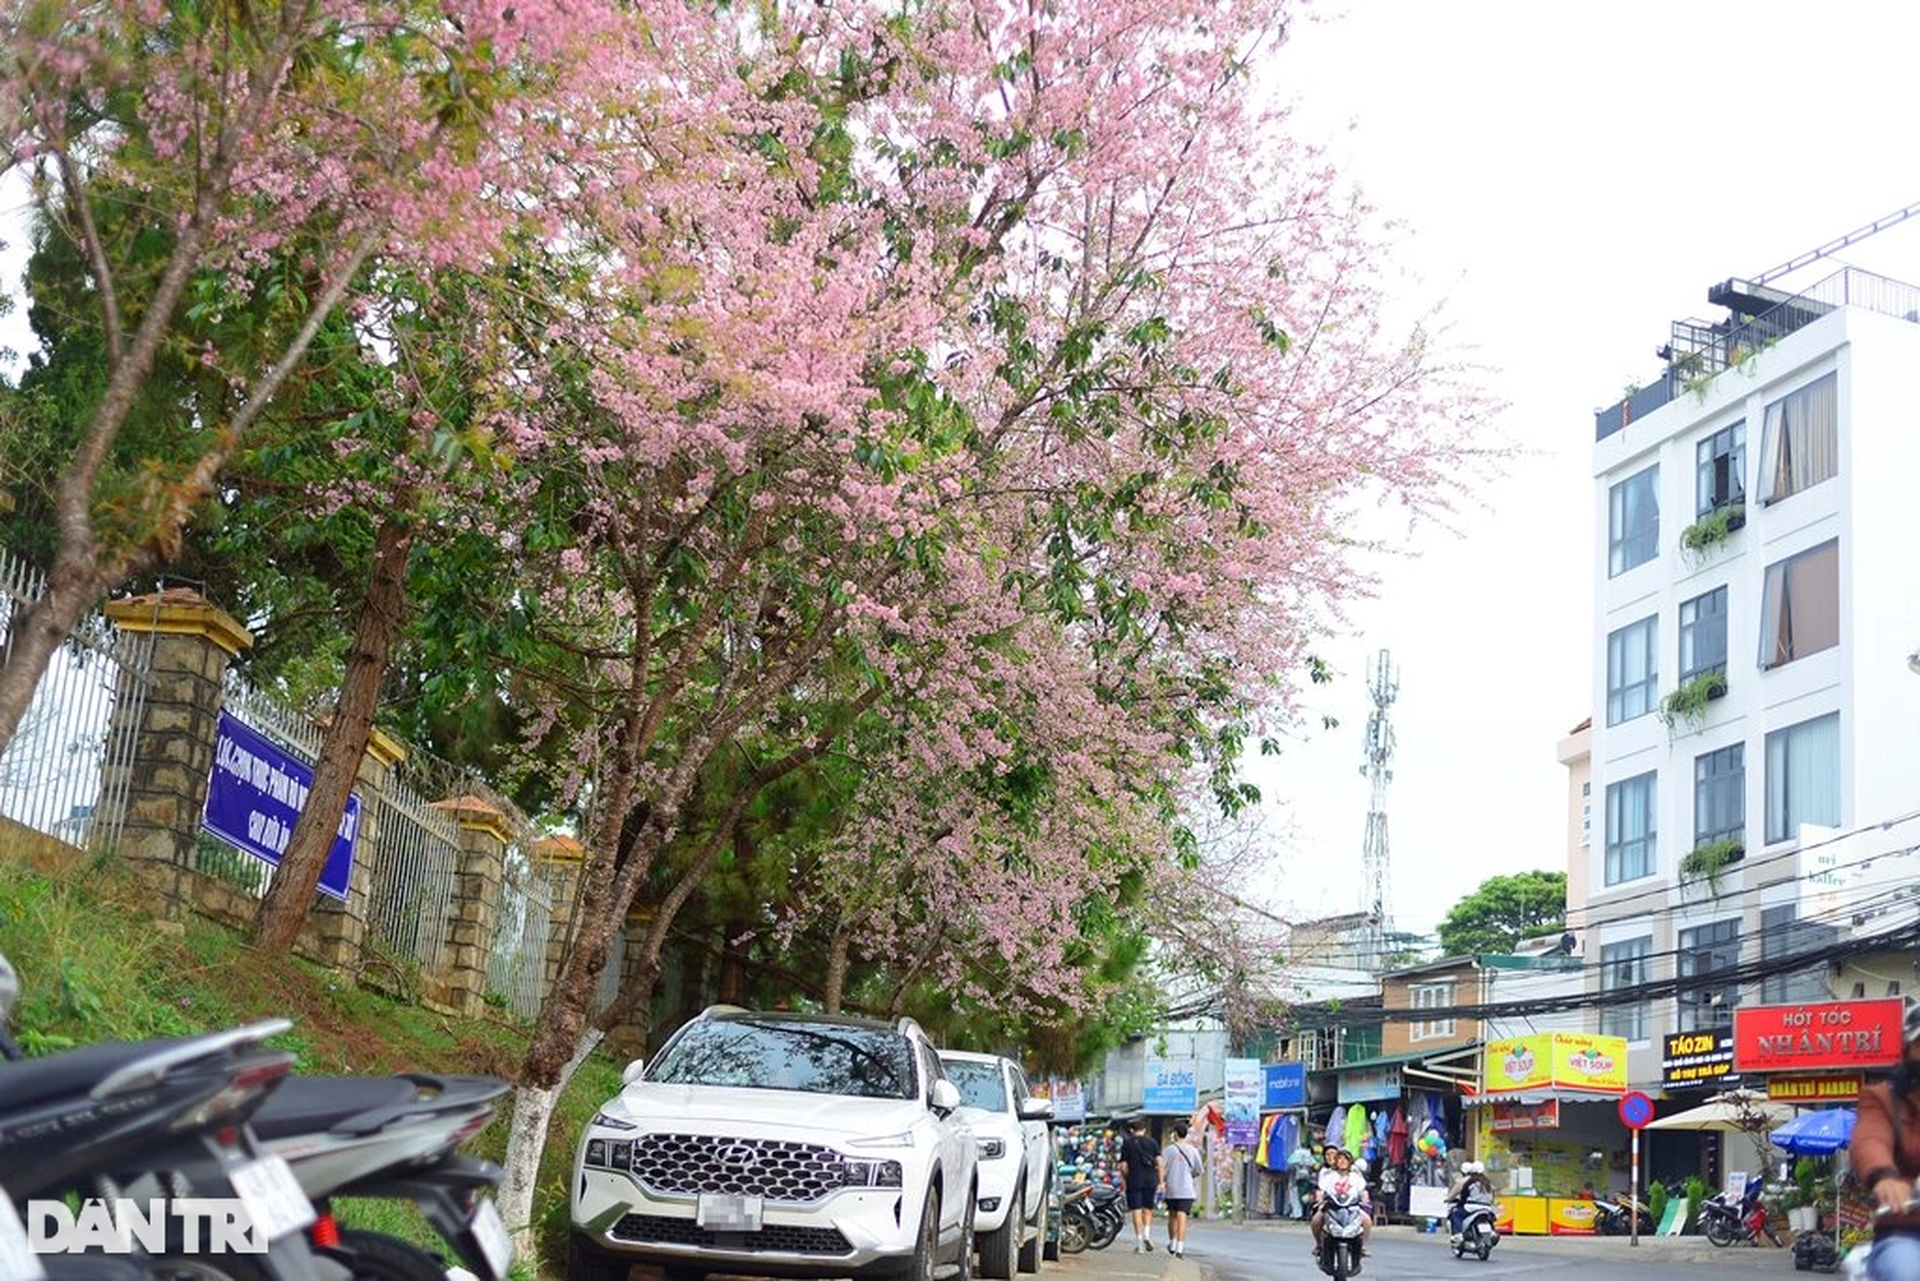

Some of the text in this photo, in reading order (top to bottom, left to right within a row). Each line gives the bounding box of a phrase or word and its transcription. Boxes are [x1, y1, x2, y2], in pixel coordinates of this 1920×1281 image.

[1783, 1005, 1852, 1026] HỚT TÓC
[1669, 1035, 1694, 1056] TÁO
[1757, 1024, 1883, 1057] NHÂN TRÍ
[1589, 1059, 1614, 1070] SOUP
